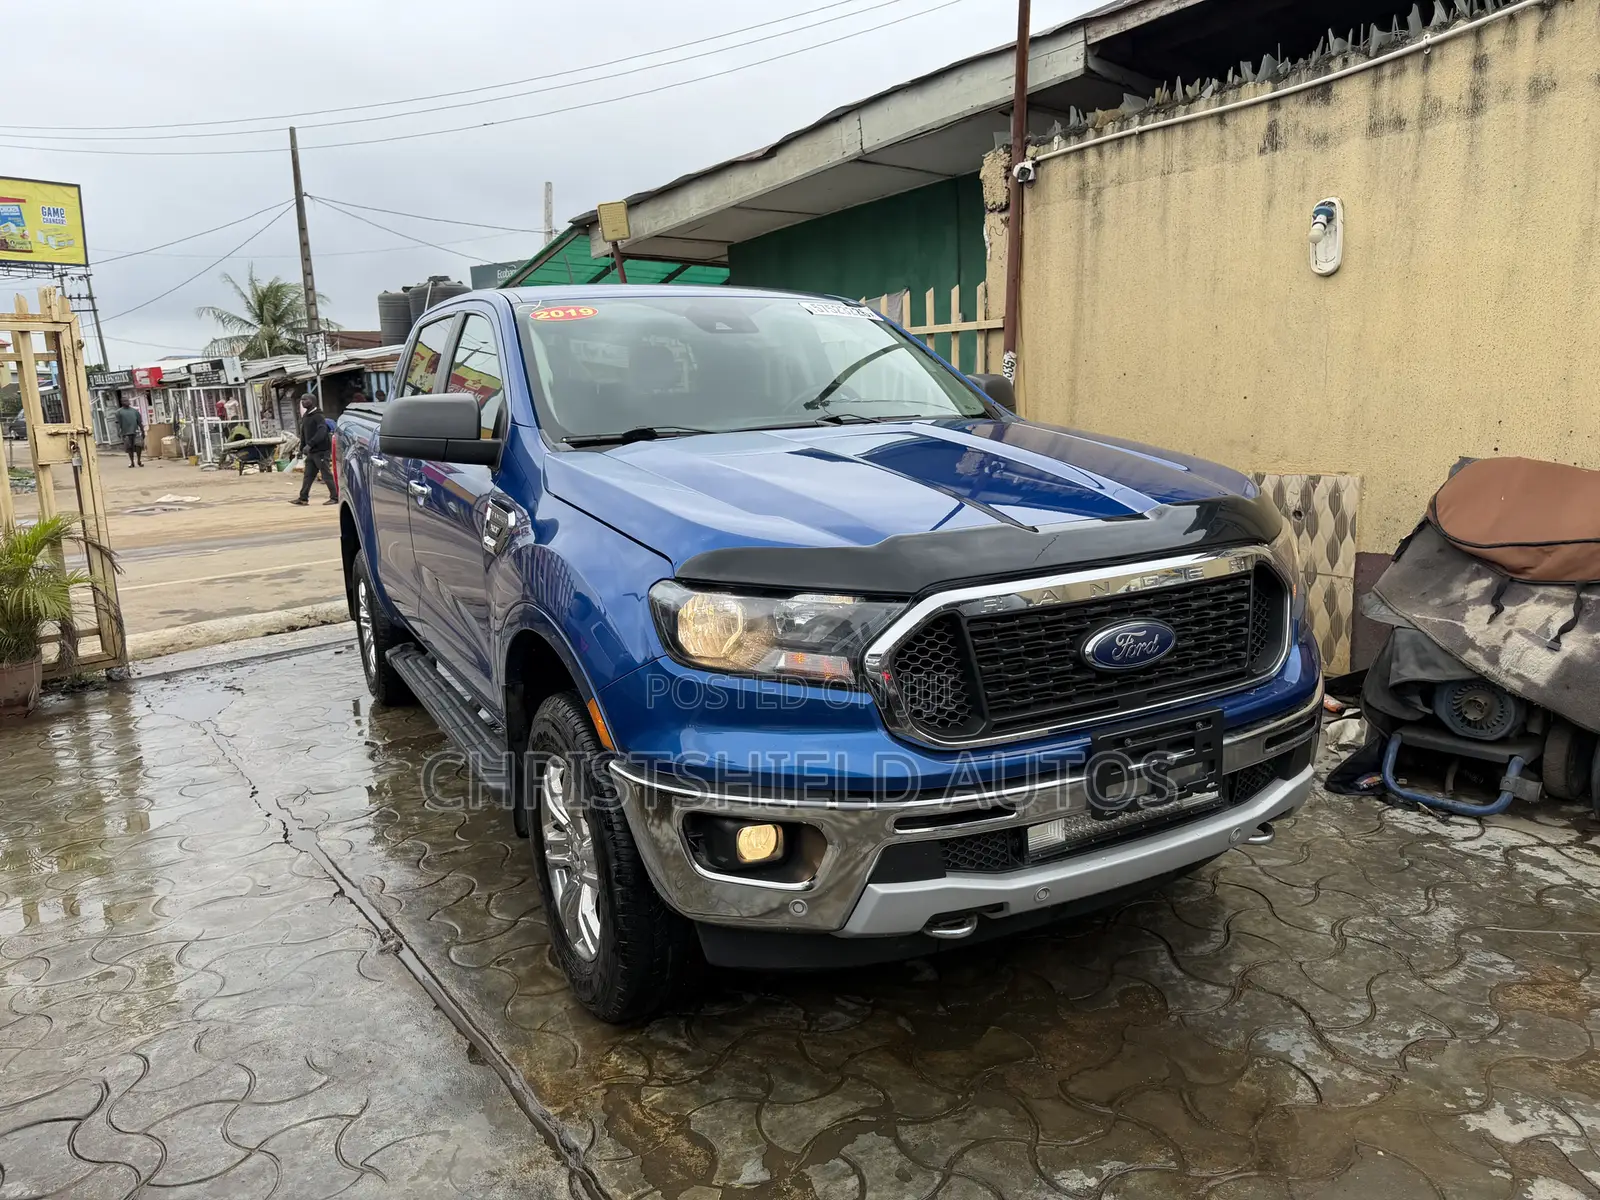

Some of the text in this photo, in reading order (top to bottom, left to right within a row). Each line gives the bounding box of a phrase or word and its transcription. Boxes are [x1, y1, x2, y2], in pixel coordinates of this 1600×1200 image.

[536, 308, 595, 320] 2019
[981, 557, 1247, 613] RANGER
[1111, 629, 1160, 661] Ford
